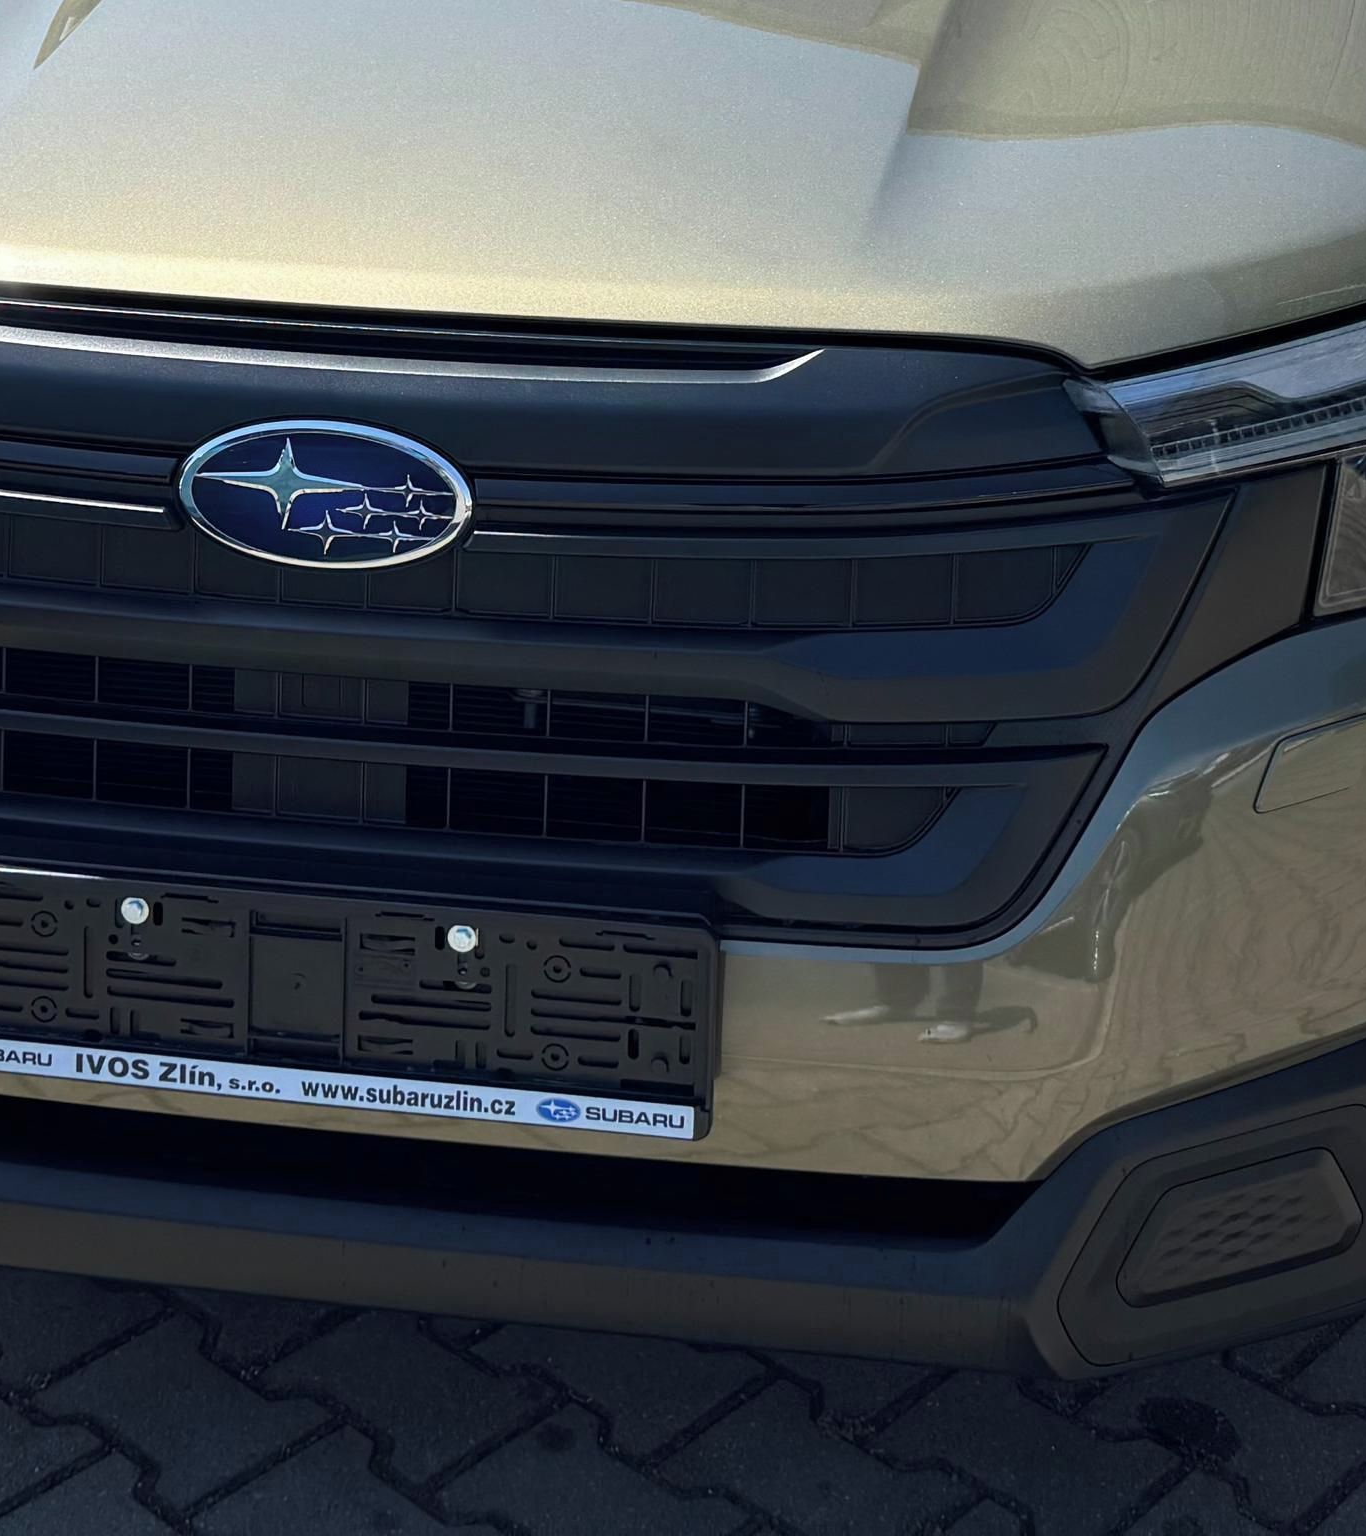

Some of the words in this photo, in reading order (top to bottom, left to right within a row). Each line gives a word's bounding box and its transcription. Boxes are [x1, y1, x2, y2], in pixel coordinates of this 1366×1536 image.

[75, 1053, 149, 1080] IVOS
[158, 1061, 222, 1091] Zlín,
[228, 1077, 281, 1094] s.r.o.
[301, 1081, 516, 1117] www.subaruzlin.cz
[585, 1106, 686, 1130] SUBARU
